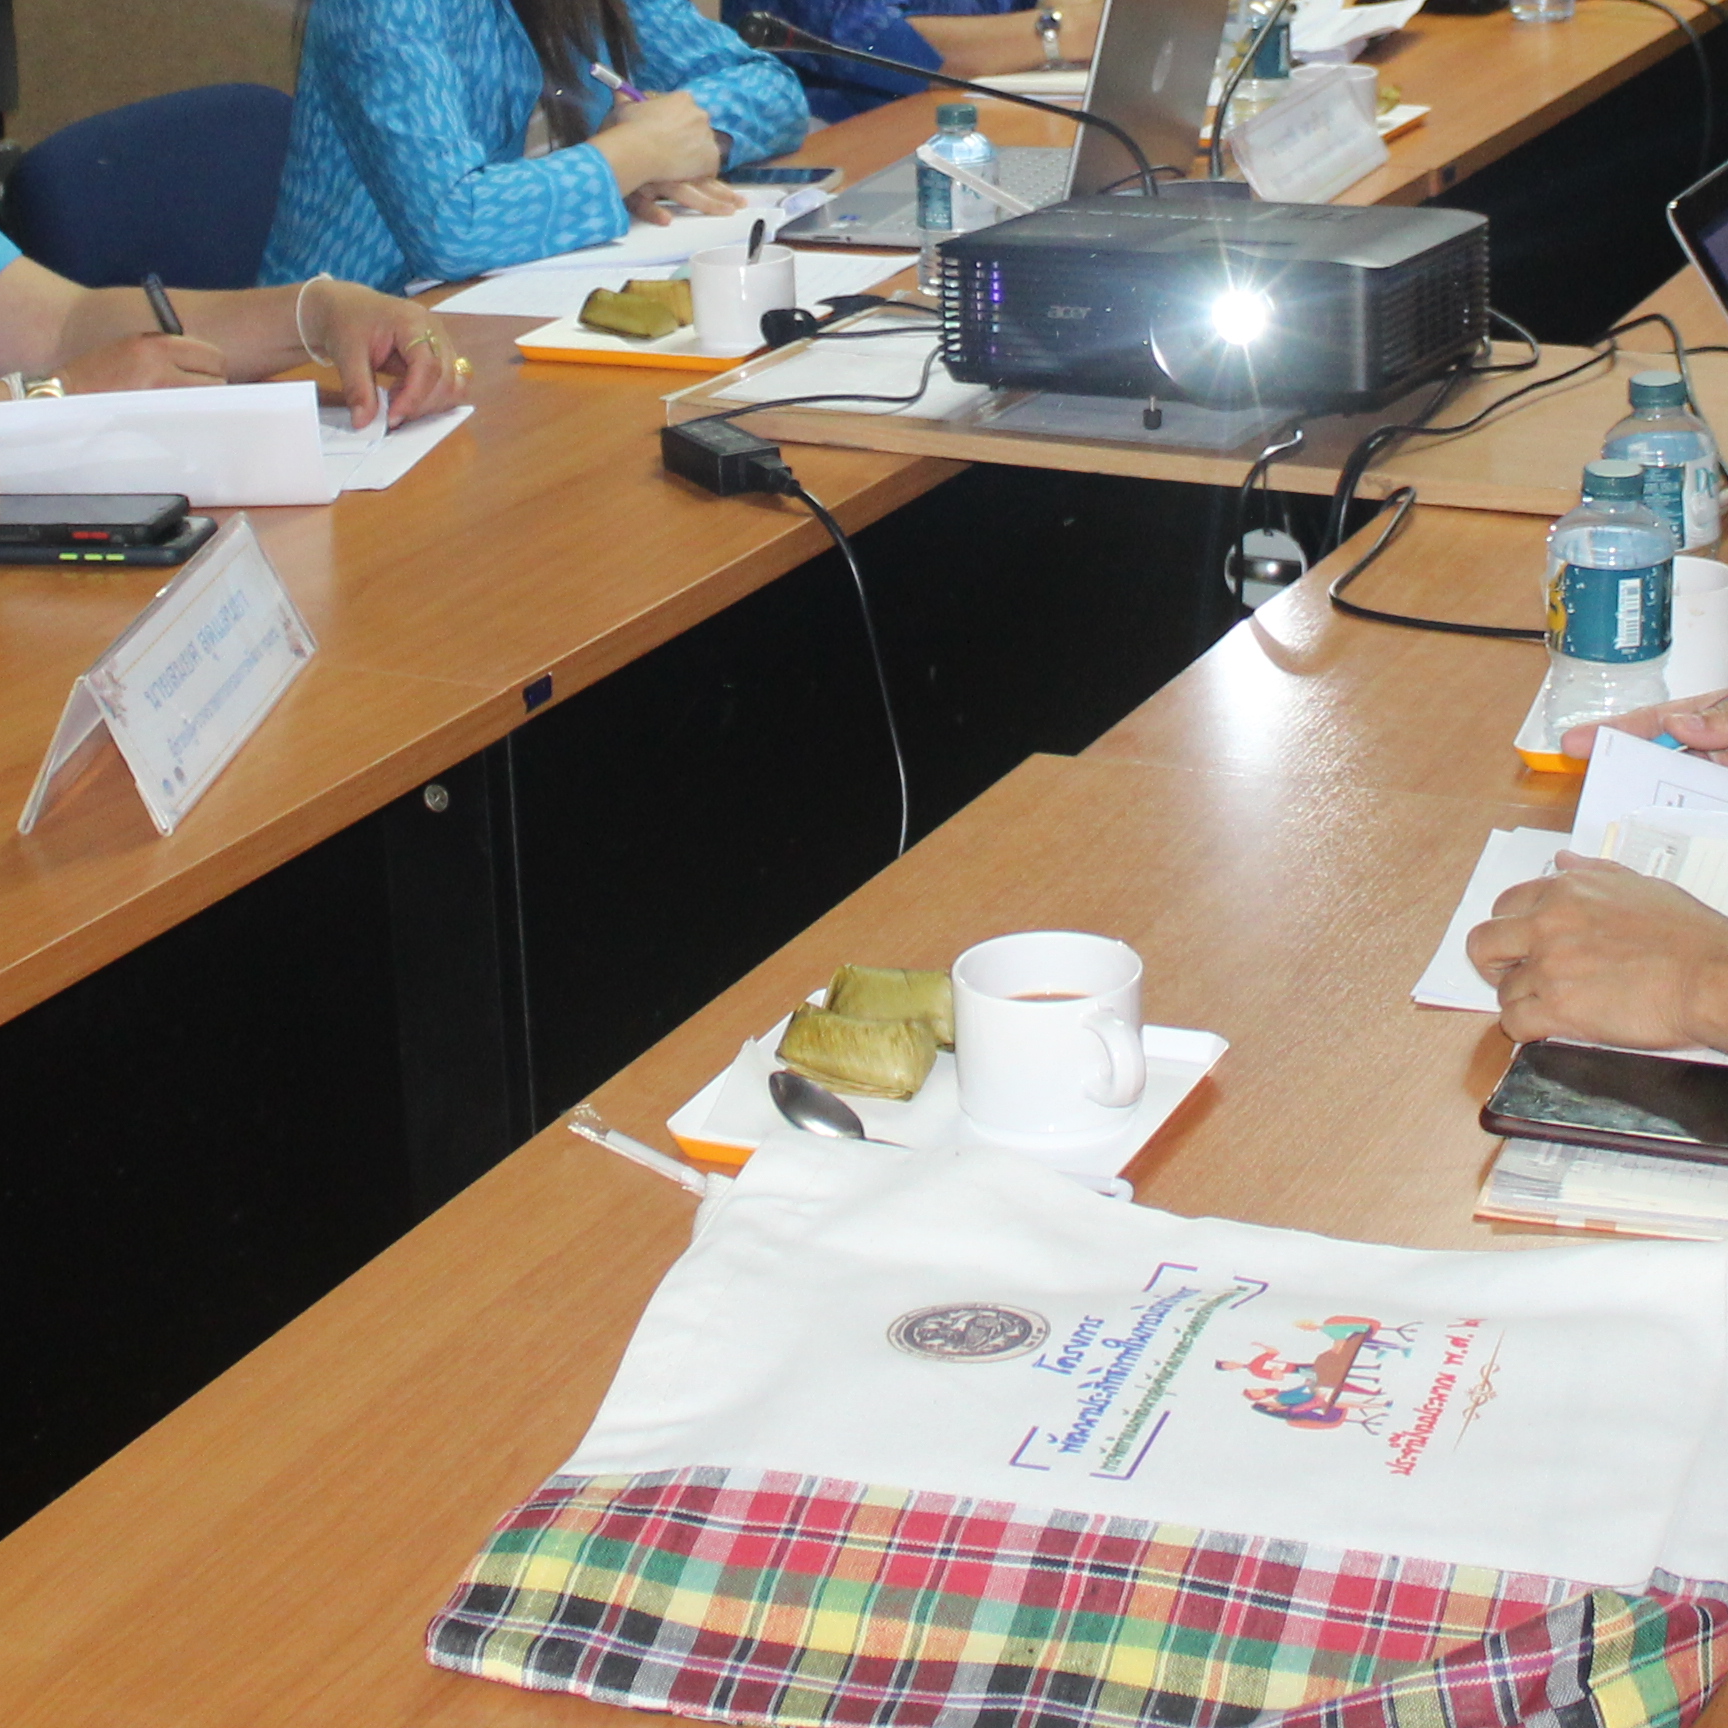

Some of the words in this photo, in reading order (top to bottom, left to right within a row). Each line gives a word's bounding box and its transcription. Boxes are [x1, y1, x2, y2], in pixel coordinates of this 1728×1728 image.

[1047, 305, 1092, 320] acer
[1032, 1315, 1105, 1376] โครงการ
[1385, 1371, 1457, 1476] ประจำปีงบประมาณ
[1443, 1334, 1475, 1366] พ.ศ.
